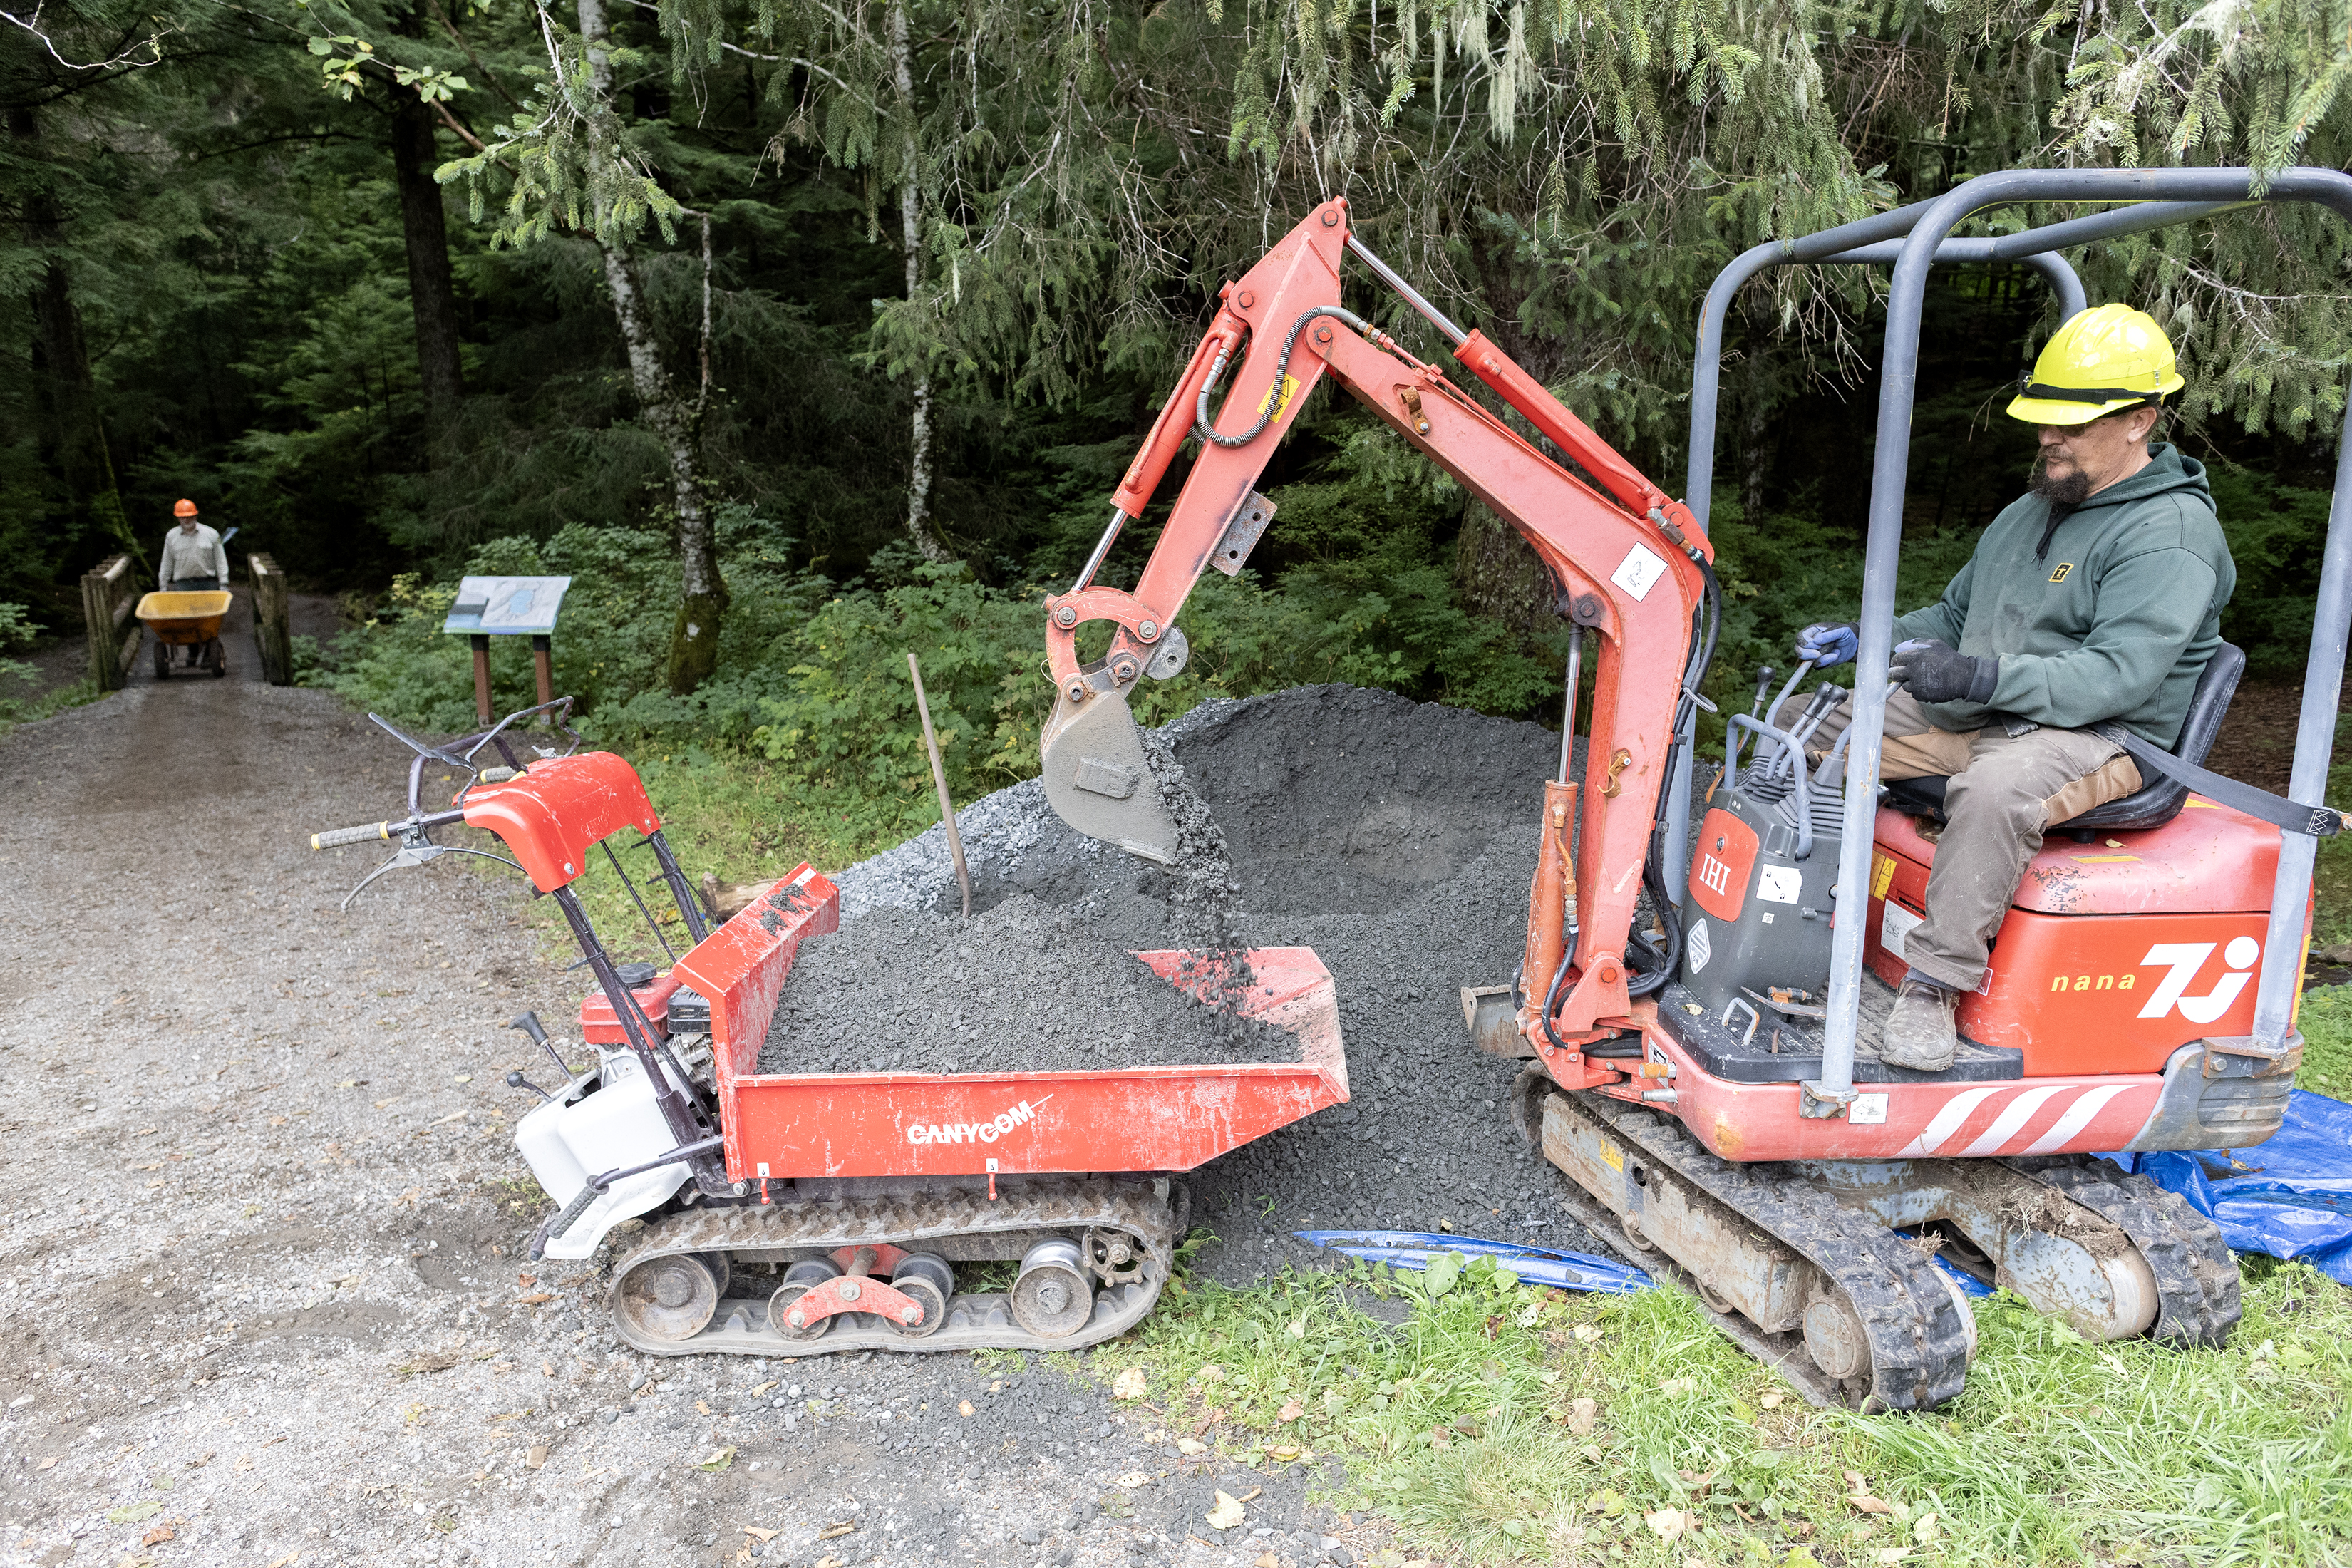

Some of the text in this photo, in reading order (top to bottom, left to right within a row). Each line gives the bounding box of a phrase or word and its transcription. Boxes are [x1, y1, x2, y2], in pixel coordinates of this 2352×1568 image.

[1699, 852, 1731, 897] IHI
[2051, 974, 2136, 991] nana
[907, 1100, 1036, 1145] CANYCOM
